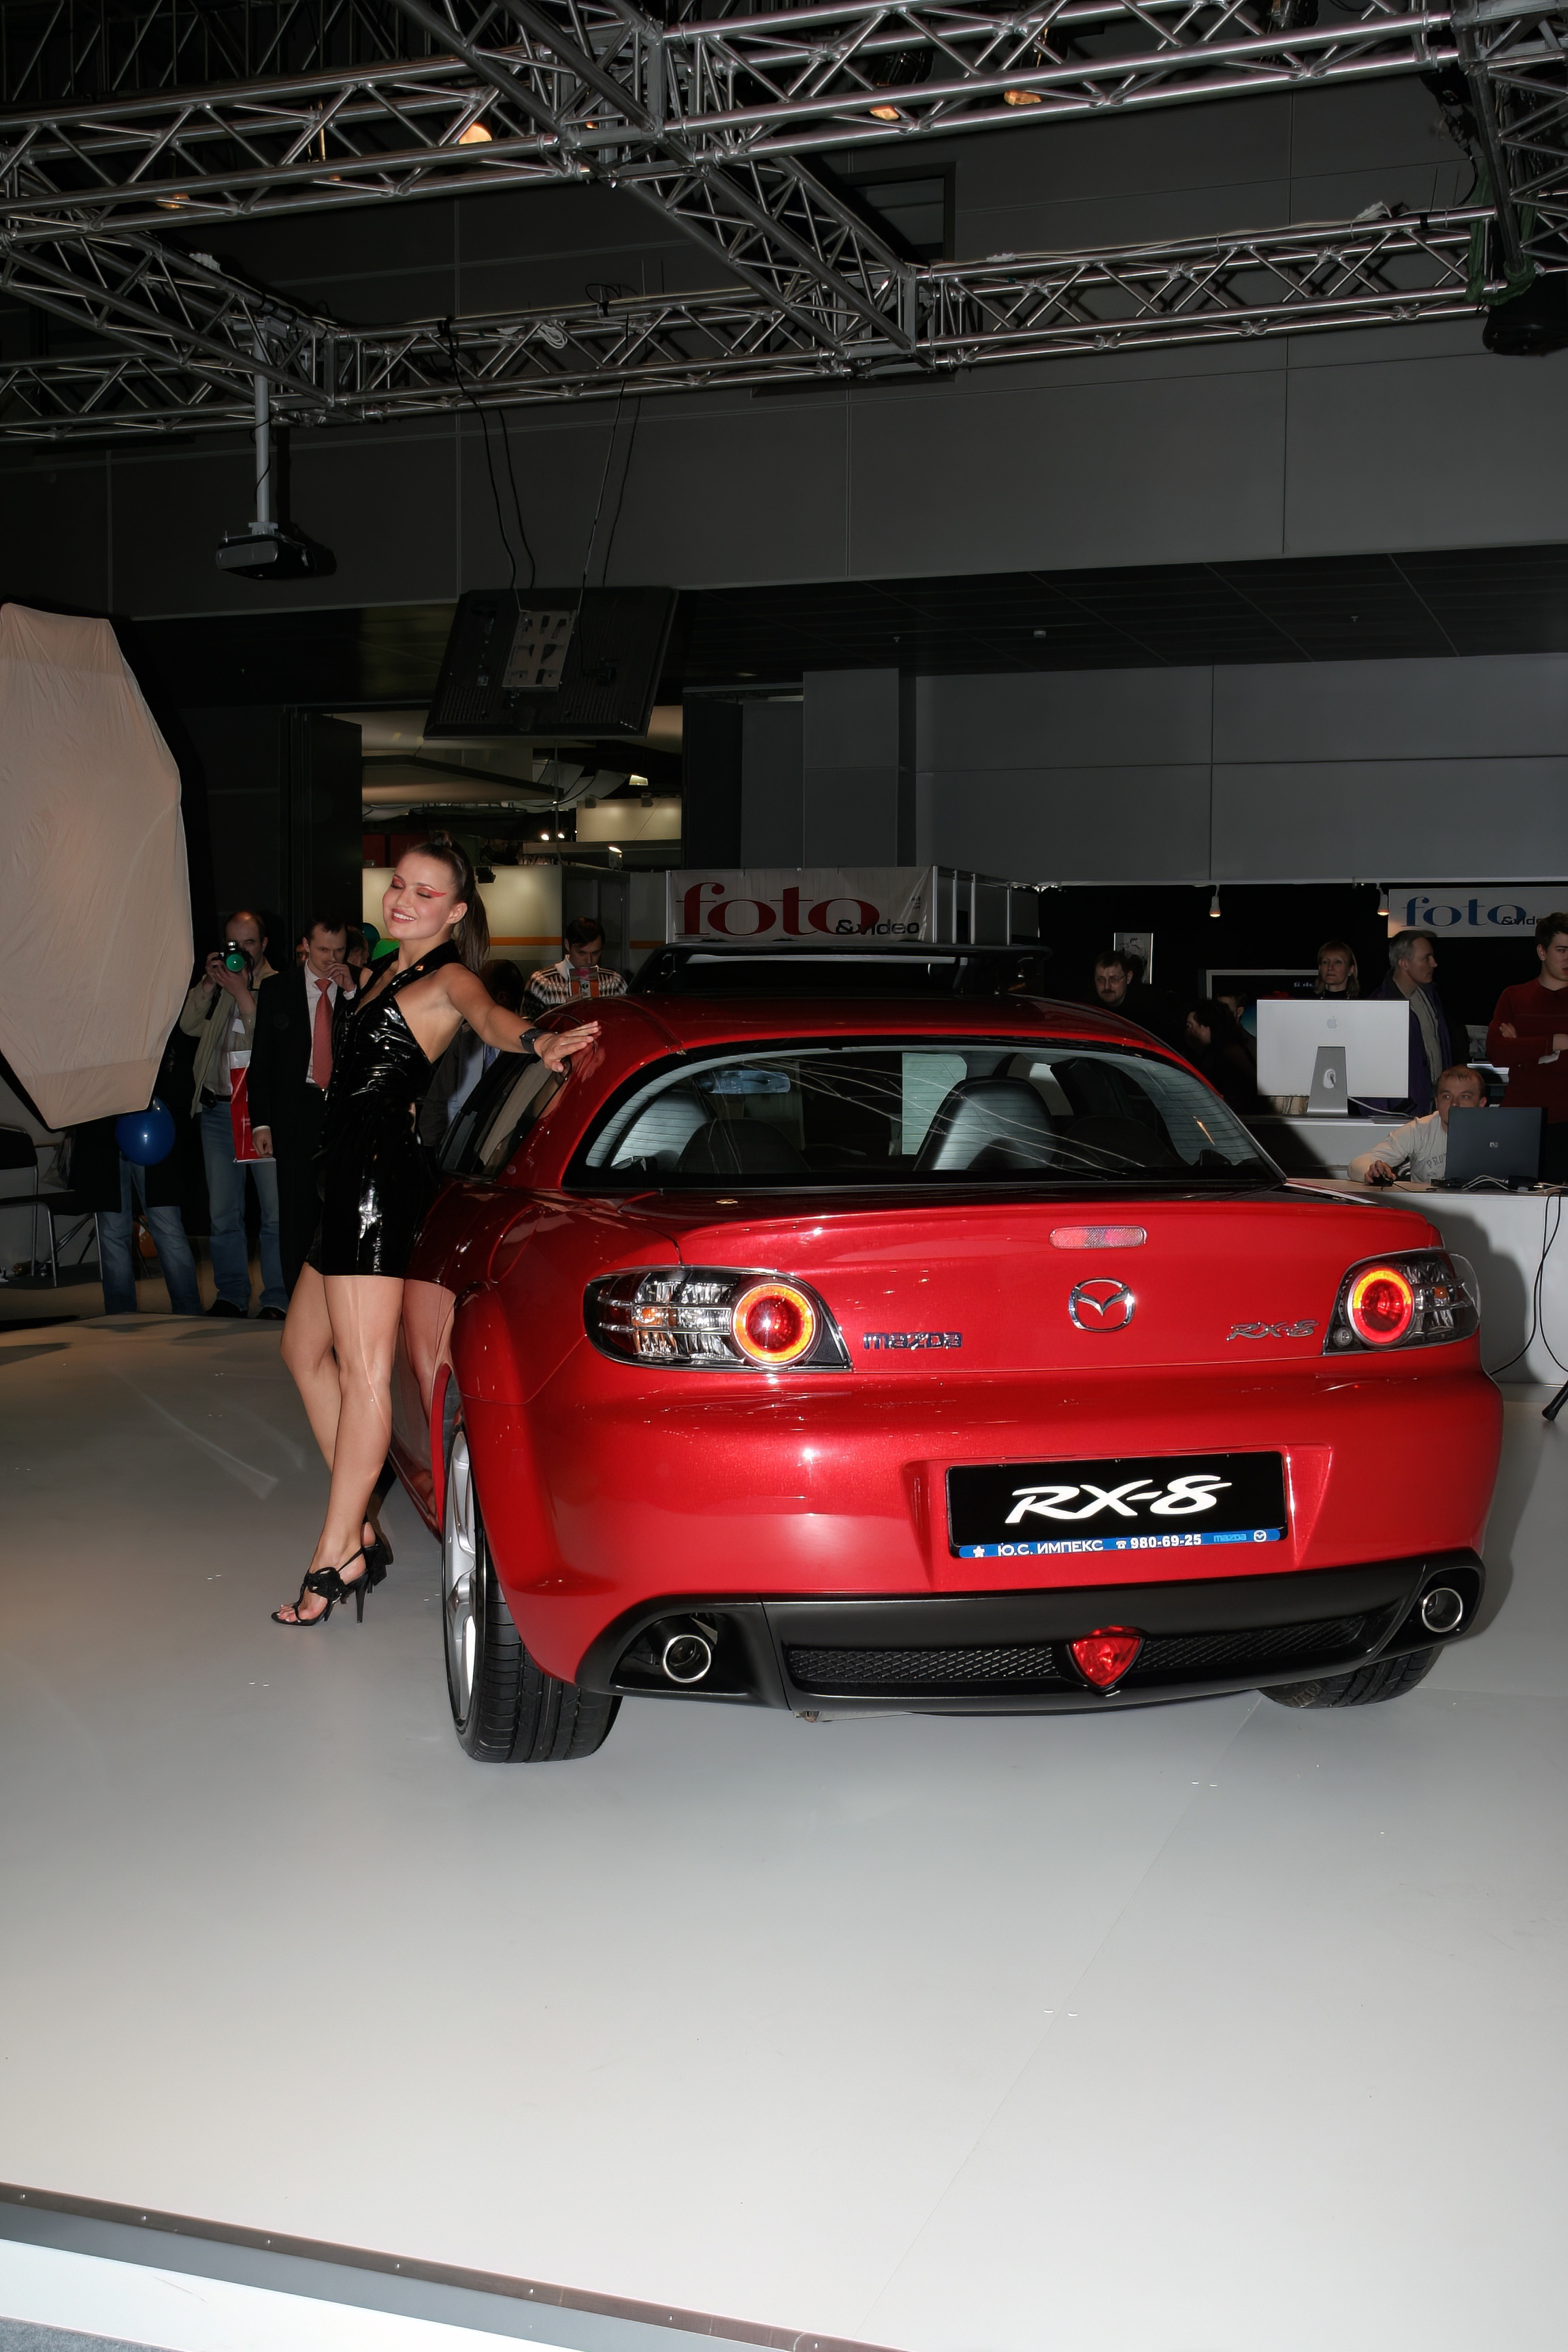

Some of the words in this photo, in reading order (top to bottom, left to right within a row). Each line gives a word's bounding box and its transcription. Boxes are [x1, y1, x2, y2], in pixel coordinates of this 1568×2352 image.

[675, 882, 880, 936] foto
[1401, 896, 1526, 928] foto
[1226, 1320, 1319, 1341] RX-8
[1004, 1474, 1232, 1524] RX-8
[997, 1544, 1033, 1556] Ю.С.
[1037, 1540, 1104, 1554] ИМПЕКС
[1130, 1534, 1201, 1549] 980-69-25
